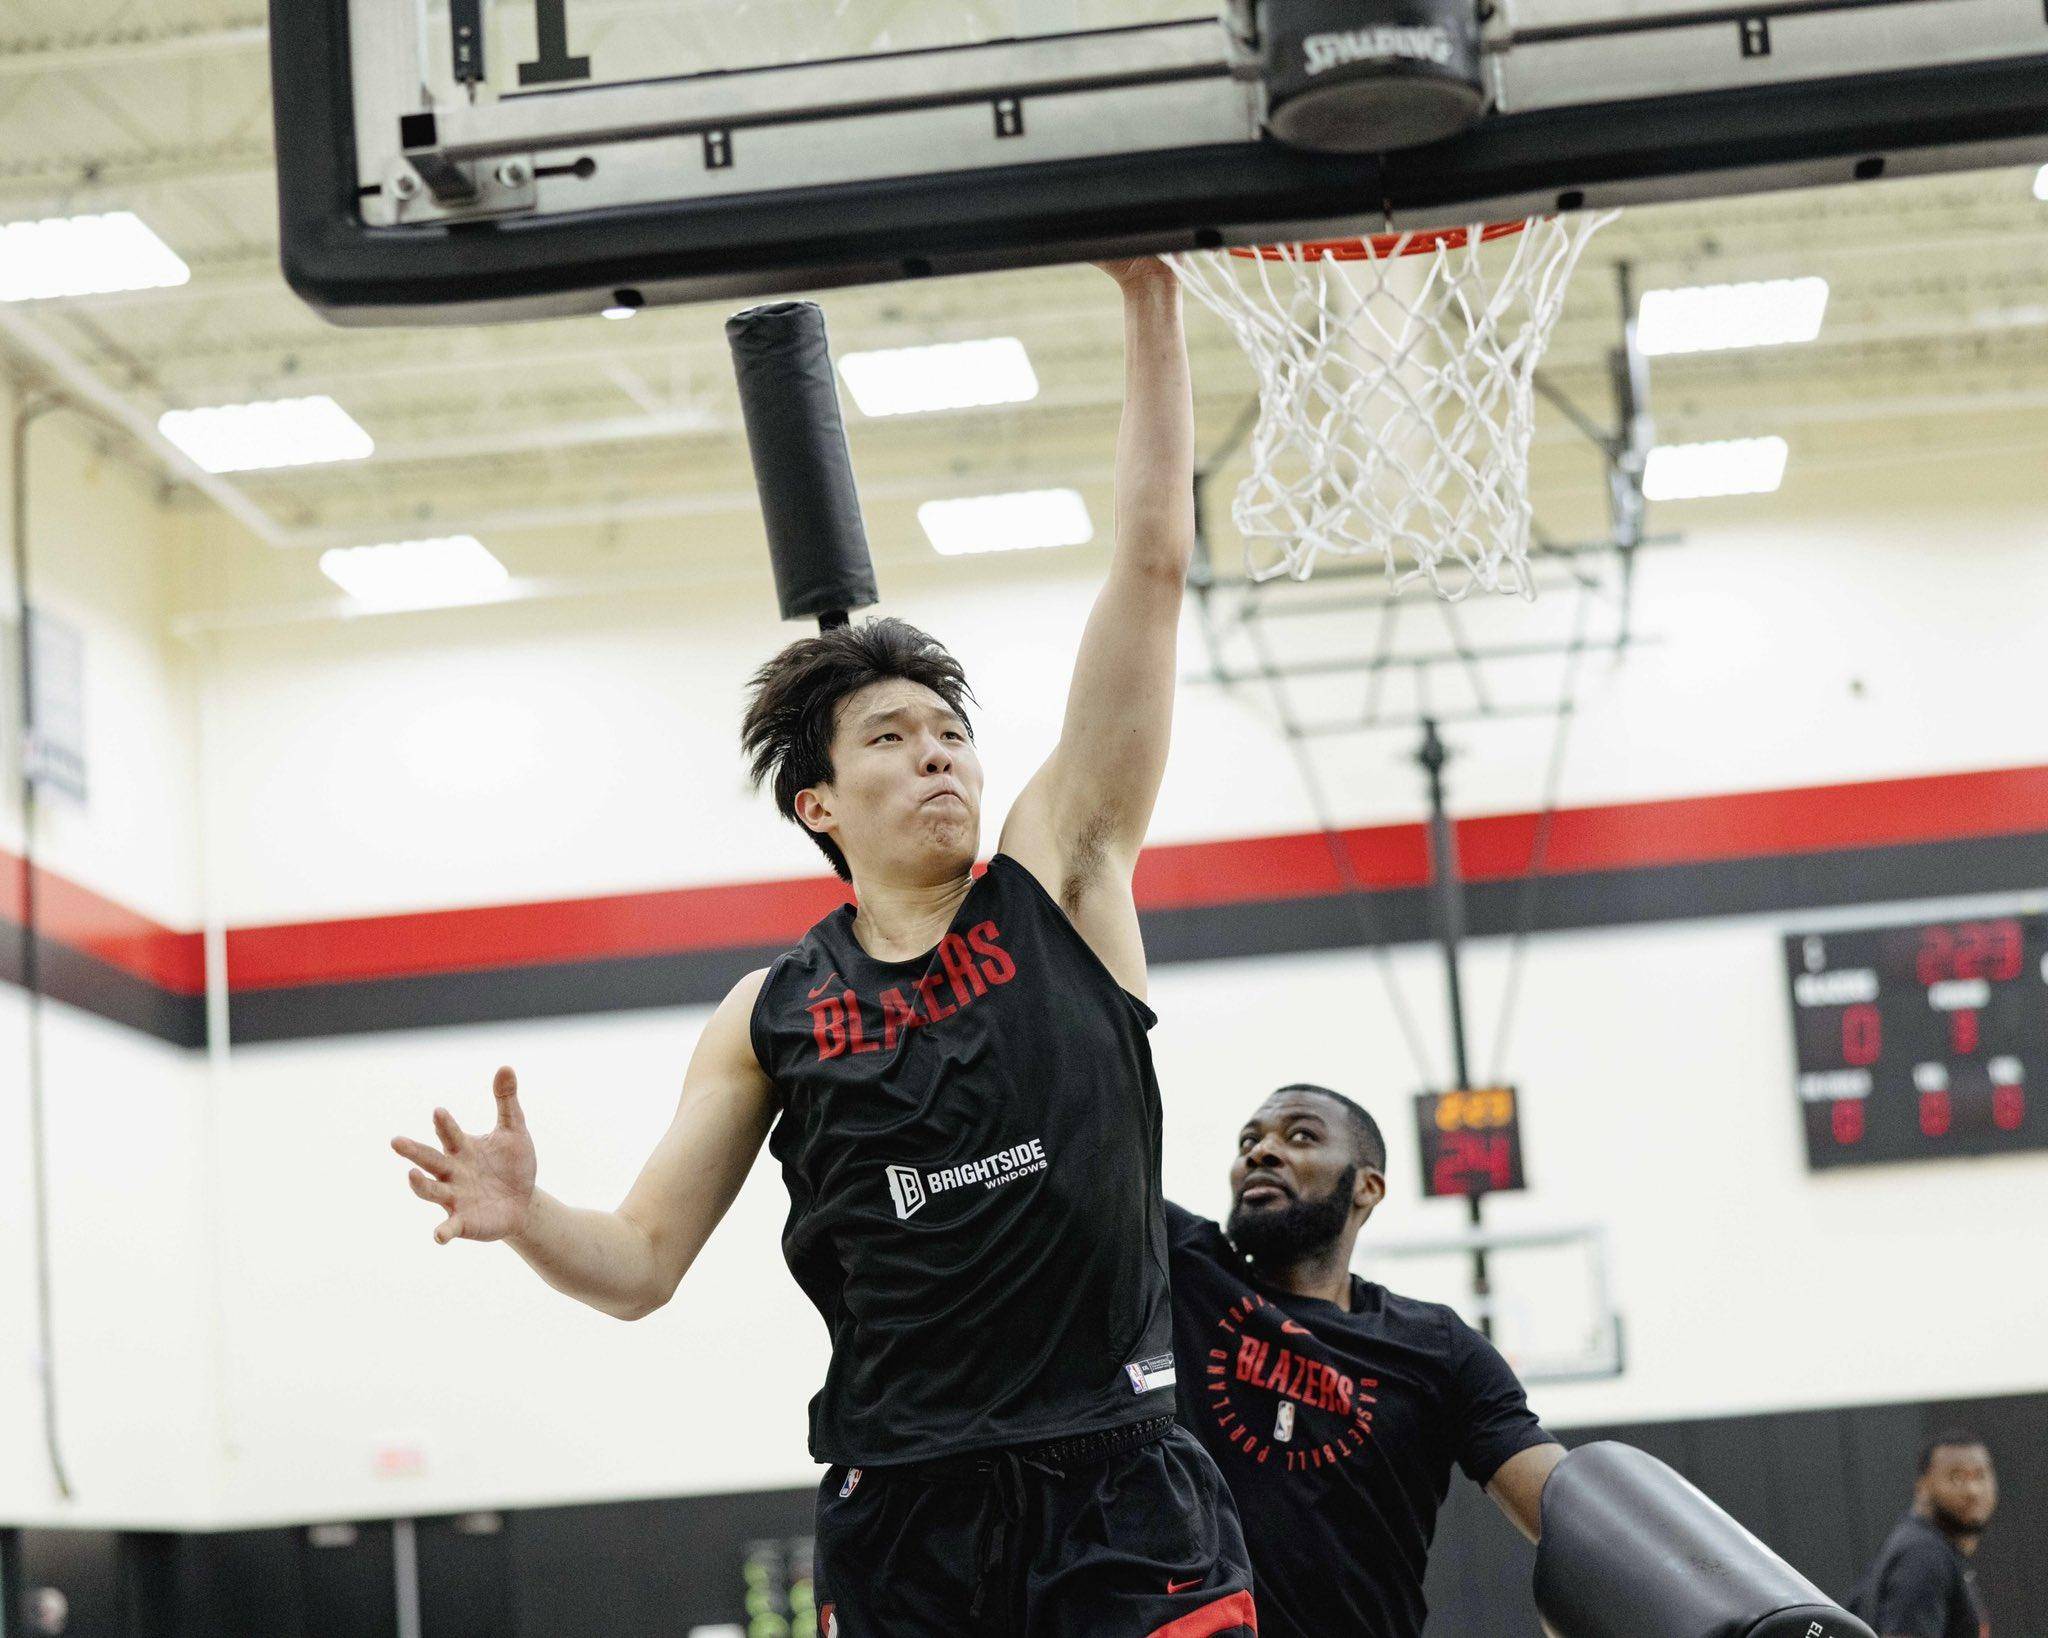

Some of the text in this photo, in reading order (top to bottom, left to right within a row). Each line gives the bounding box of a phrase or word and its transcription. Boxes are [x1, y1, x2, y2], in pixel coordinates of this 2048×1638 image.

[1303, 25, 1452, 76] SPALDING
[804, 920, 1016, 1062] BLAERS
[927, 1138, 1046, 1194] BRIGHTSIDE
[984, 1159, 1048, 1190] WINDOWS
[1434, 1132, 1510, 1196] 24
[1207, 1348, 1270, 1463] PORTLAND
[1235, 1333, 1354, 1416] BLAZERS
[1287, 1378, 1378, 1472] BASKETBALL
